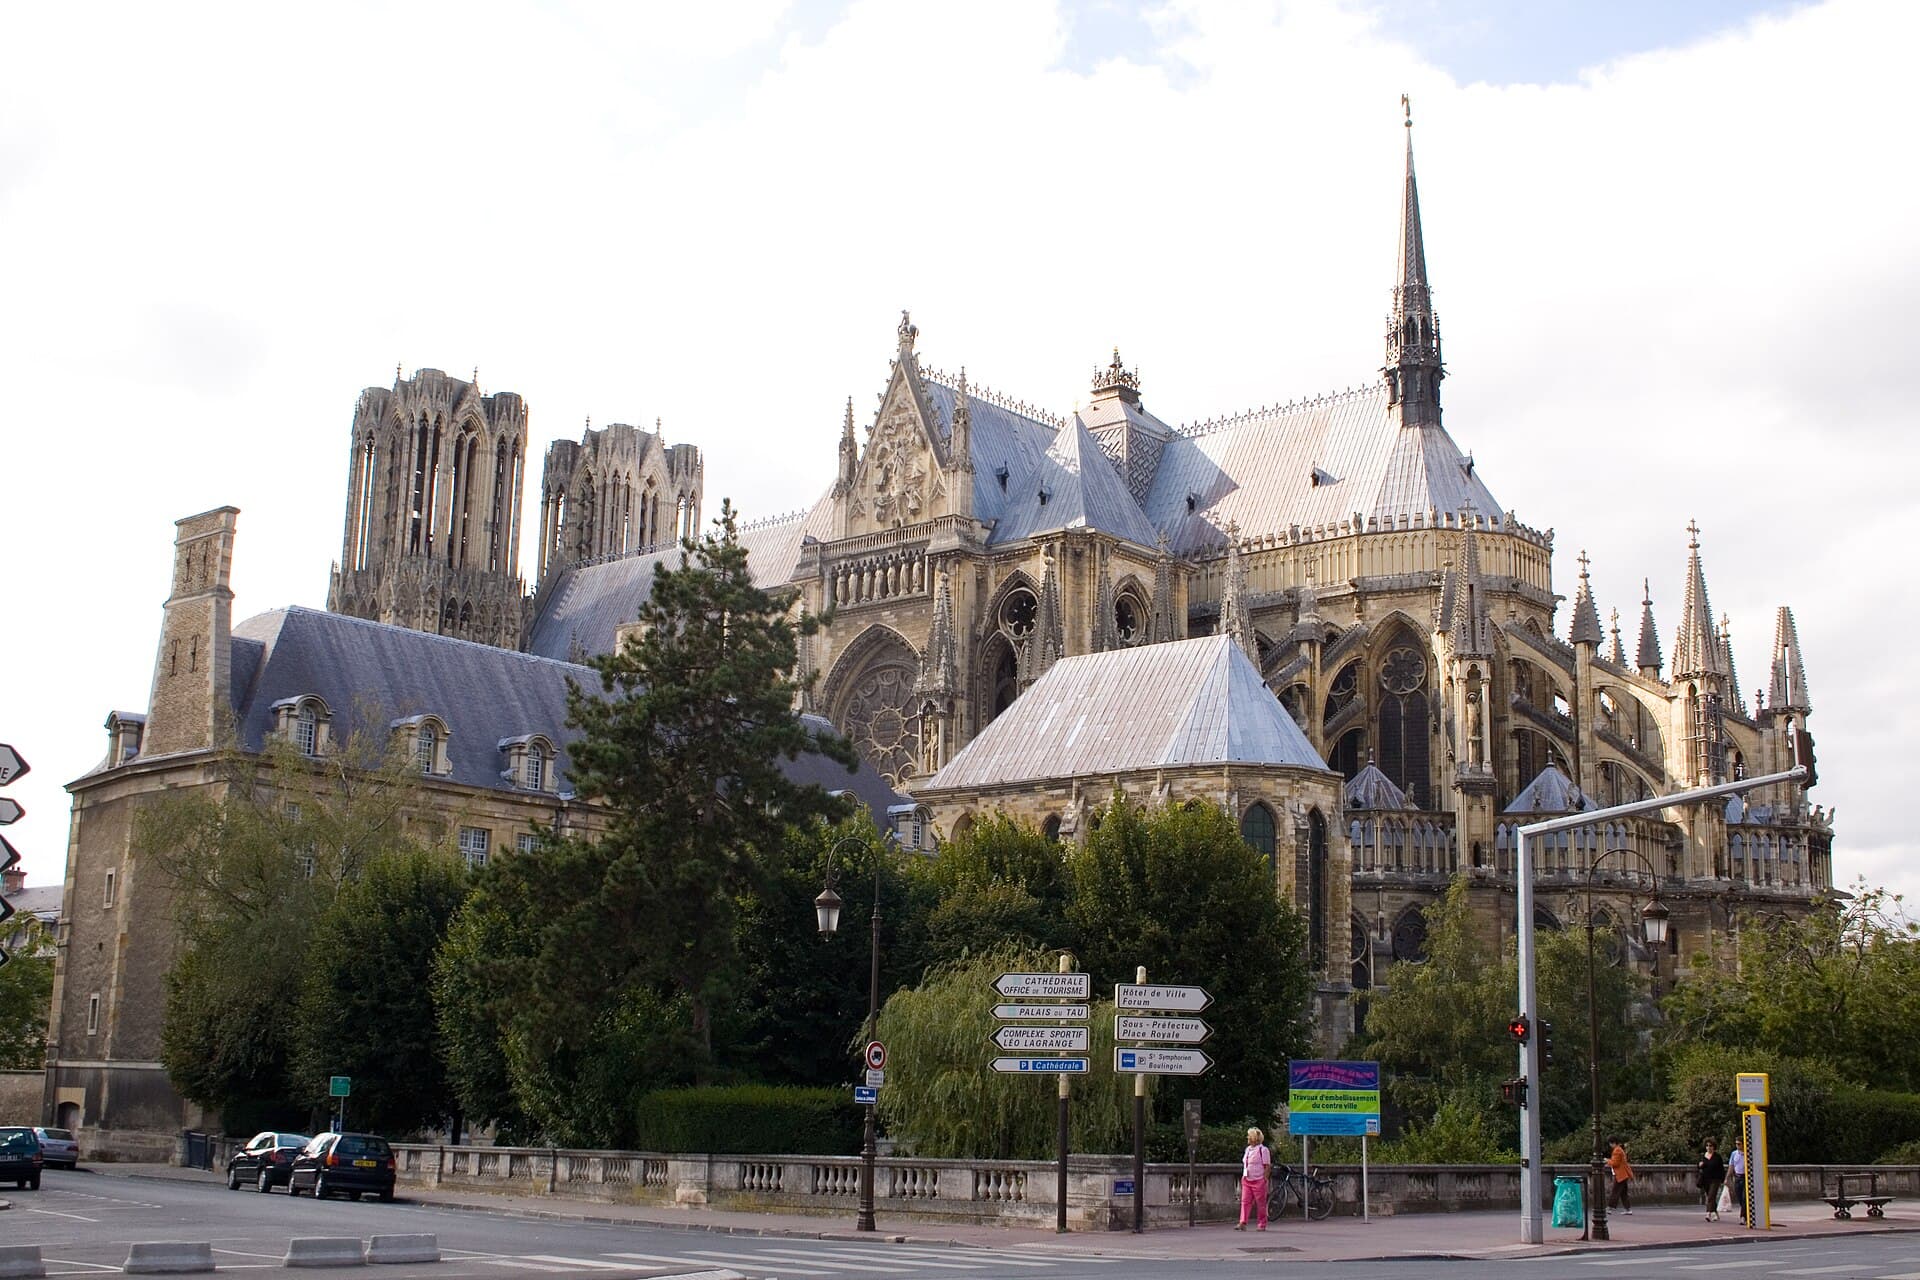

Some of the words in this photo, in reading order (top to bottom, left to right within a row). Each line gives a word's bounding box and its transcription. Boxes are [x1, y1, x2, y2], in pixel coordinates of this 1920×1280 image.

[1025, 976, 1083, 985] CATHÉDRALE
[1004, 986, 1030, 994] OFFICE
[1043, 986, 1083, 994] TOURISME
[1122, 988, 1147, 997] Hôtel
[1150, 989, 1161, 997] de
[1166, 990, 1187, 998] Ville
[1122, 997, 1150, 1006] Forum
[1019, 1008, 1051, 1016] PALAIS
[1066, 1008, 1083, 1016] TAU
[1003, 1030, 1045, 1038] COMPLEXE
[1050, 1030, 1083, 1038] SPORTIF
[1122, 1029, 1146, 1037] Place
[1150, 1030, 1180, 1039] Royale
[1024, 1039, 1073, 1047] LAGRANGE
